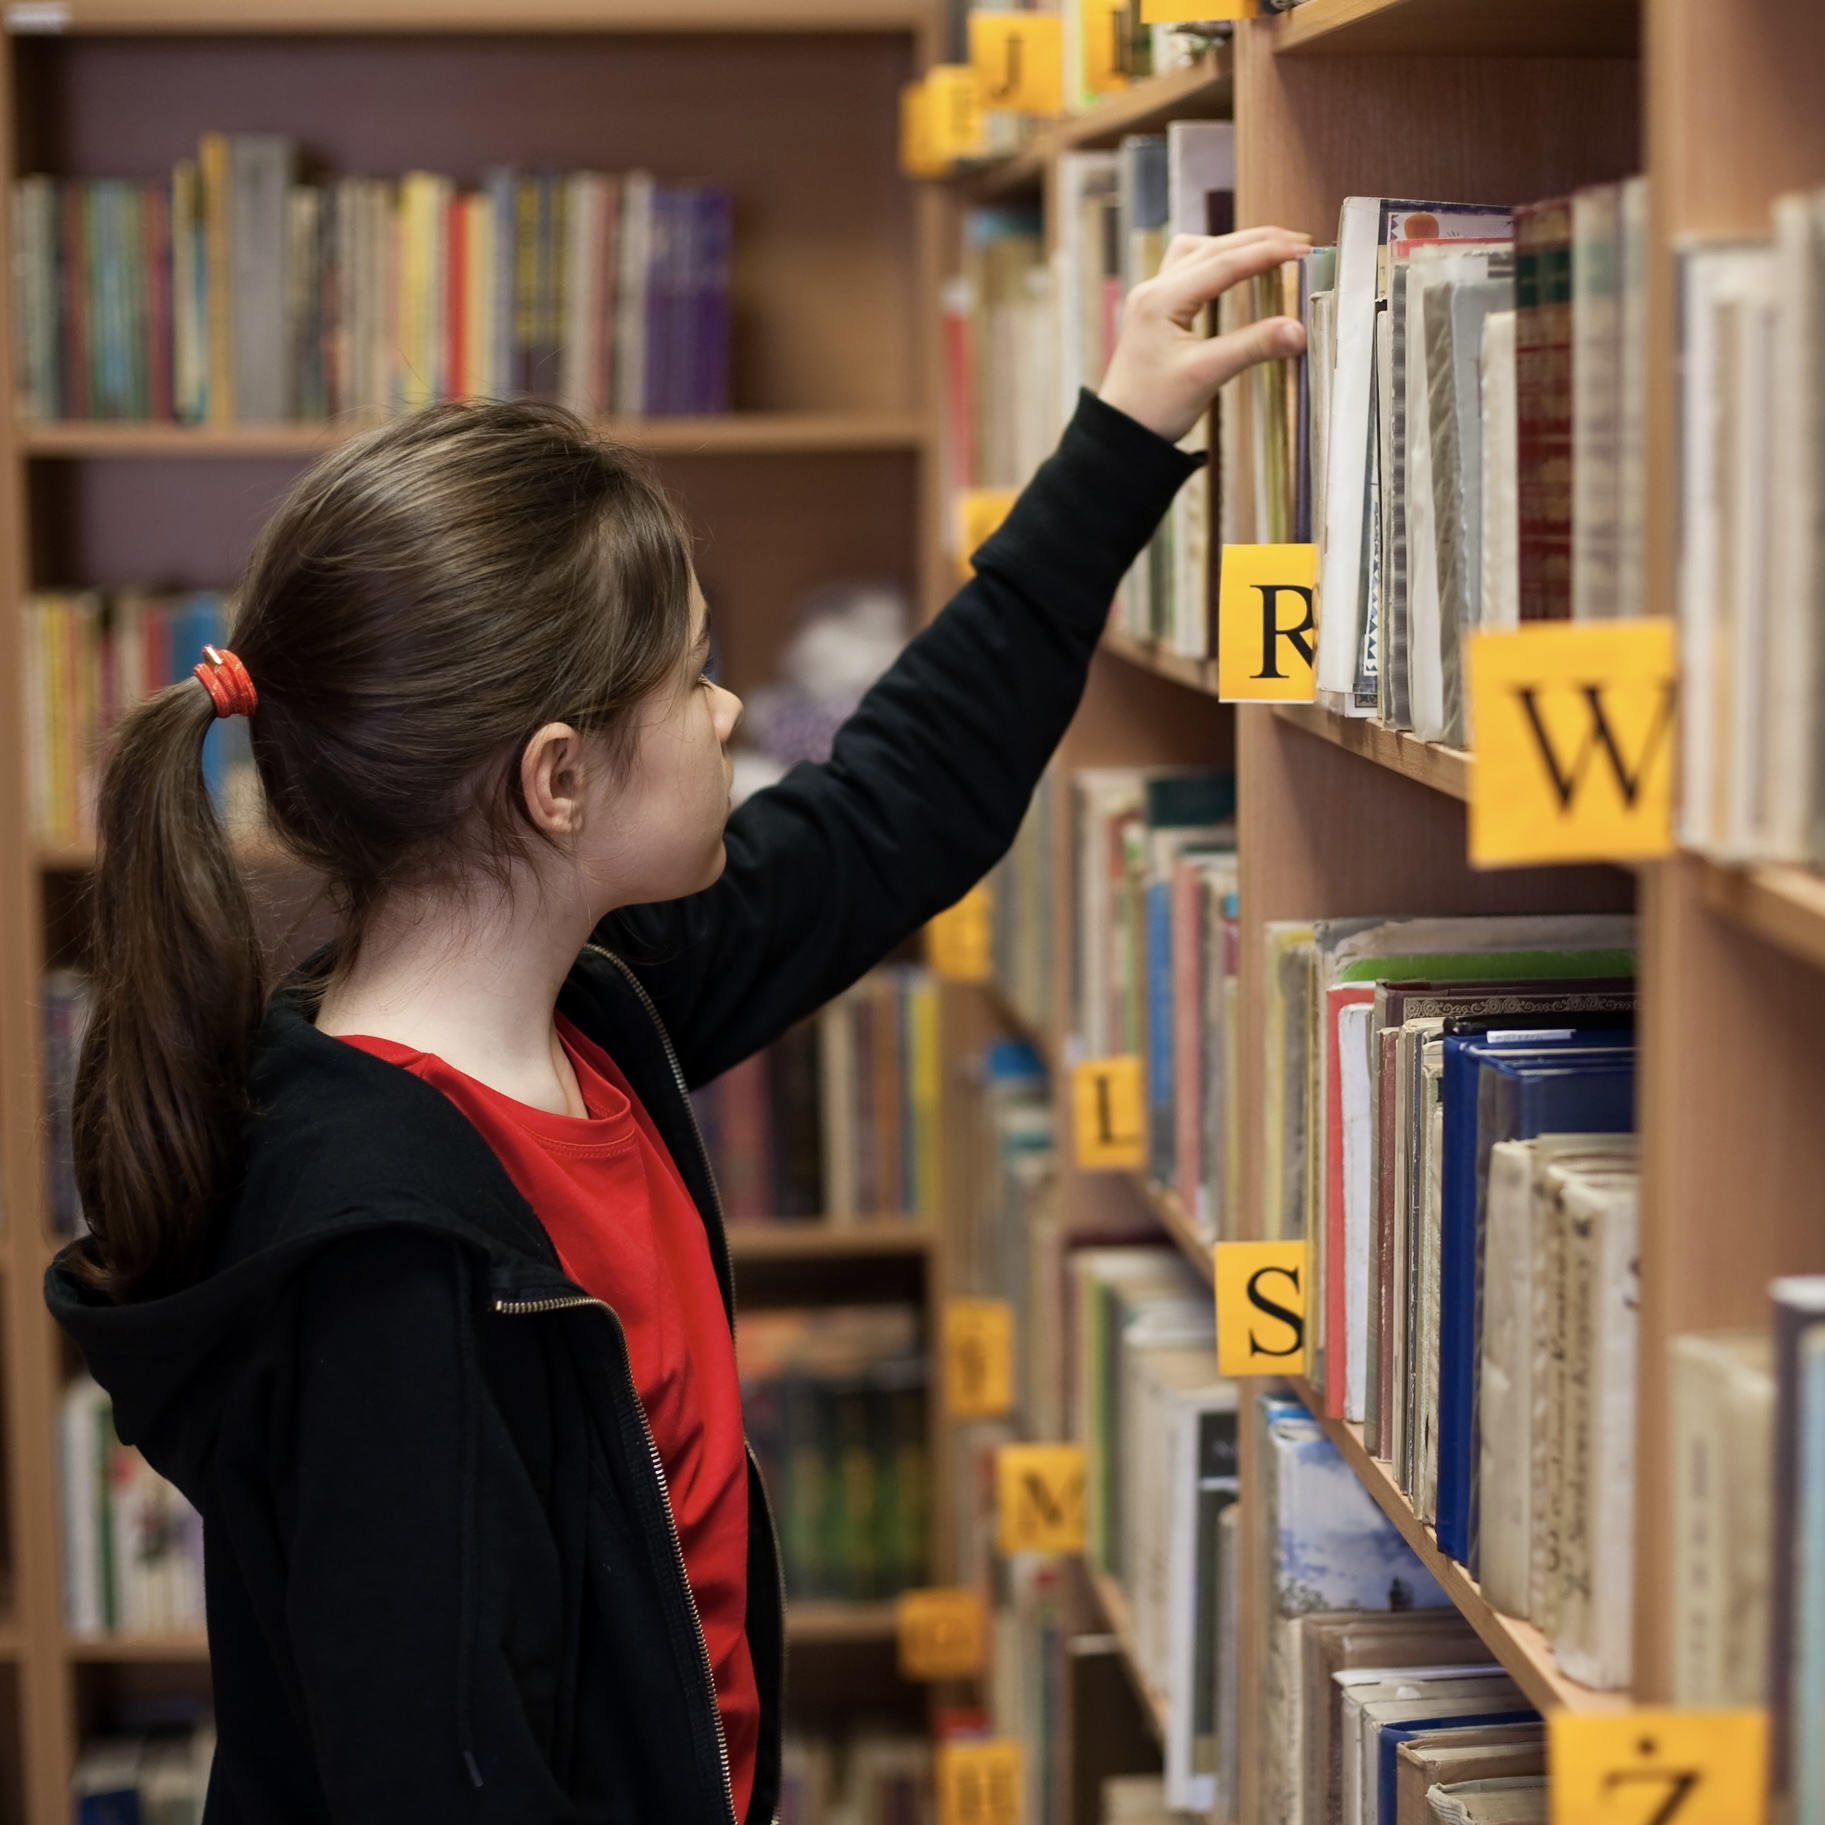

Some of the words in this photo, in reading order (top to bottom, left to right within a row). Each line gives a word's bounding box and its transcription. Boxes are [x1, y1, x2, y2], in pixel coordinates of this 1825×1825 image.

[1249, 584, 1314, 679] R
[1509, 681, 1676, 811] W
[1246, 1267, 1305, 1357] S
